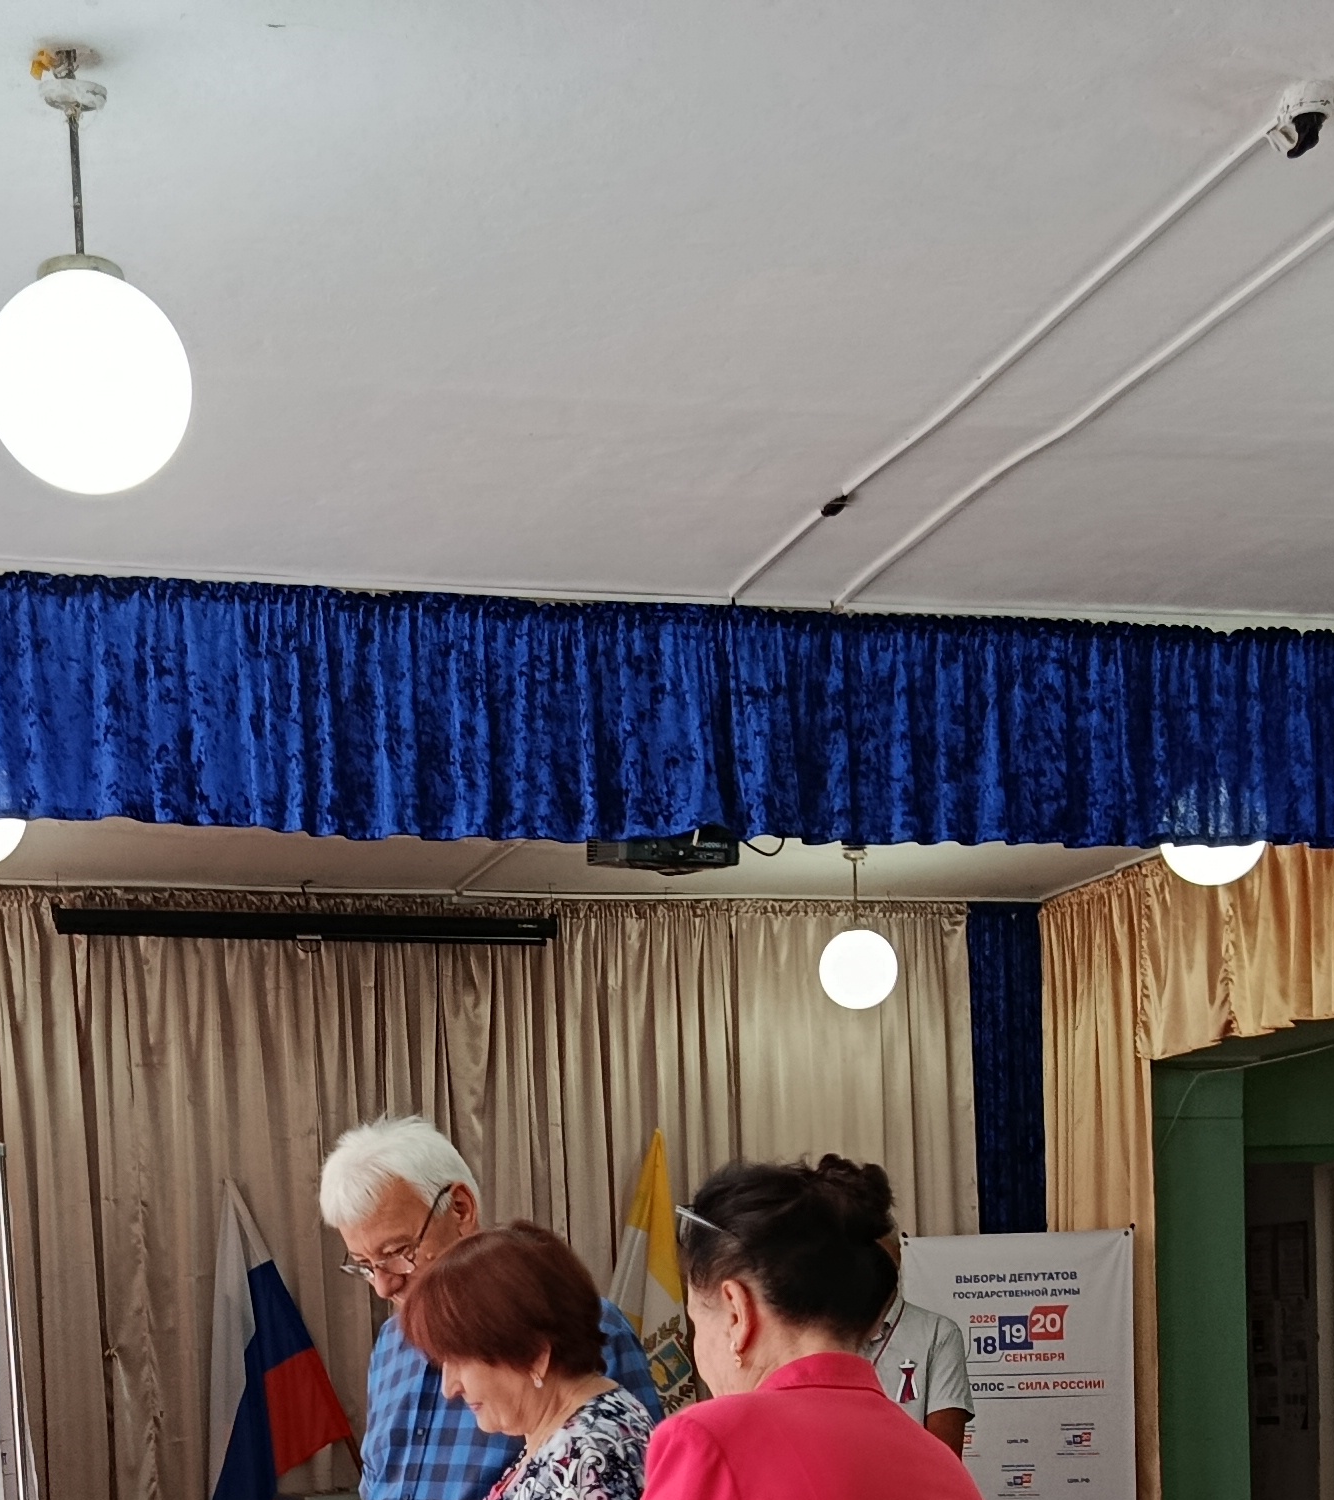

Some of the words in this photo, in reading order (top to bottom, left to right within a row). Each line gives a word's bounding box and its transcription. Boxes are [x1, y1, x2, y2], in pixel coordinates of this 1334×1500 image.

[955, 1274, 1006, 1284] ВЫБОРЫ
[1009, 1271, 1078, 1283] ДЕПУТАТОВ
[953, 1287, 1048, 1299] ГОСУДАРСТВЕННОЙ
[1050, 1287, 1080, 1297] ДУМЫ
[970, 1315, 996, 1323] 2026
[973, 1336, 997, 1355] 18
[1001, 1324, 1026, 1344] 19
[1031, 1313, 1061, 1333] 20
[1004, 1352, 1065, 1363] СЕНТЯБРЯ
[1018, 1381, 1050, 1390] СИЛА
[1053, 1380, 1105, 1390] РОССИИ!
